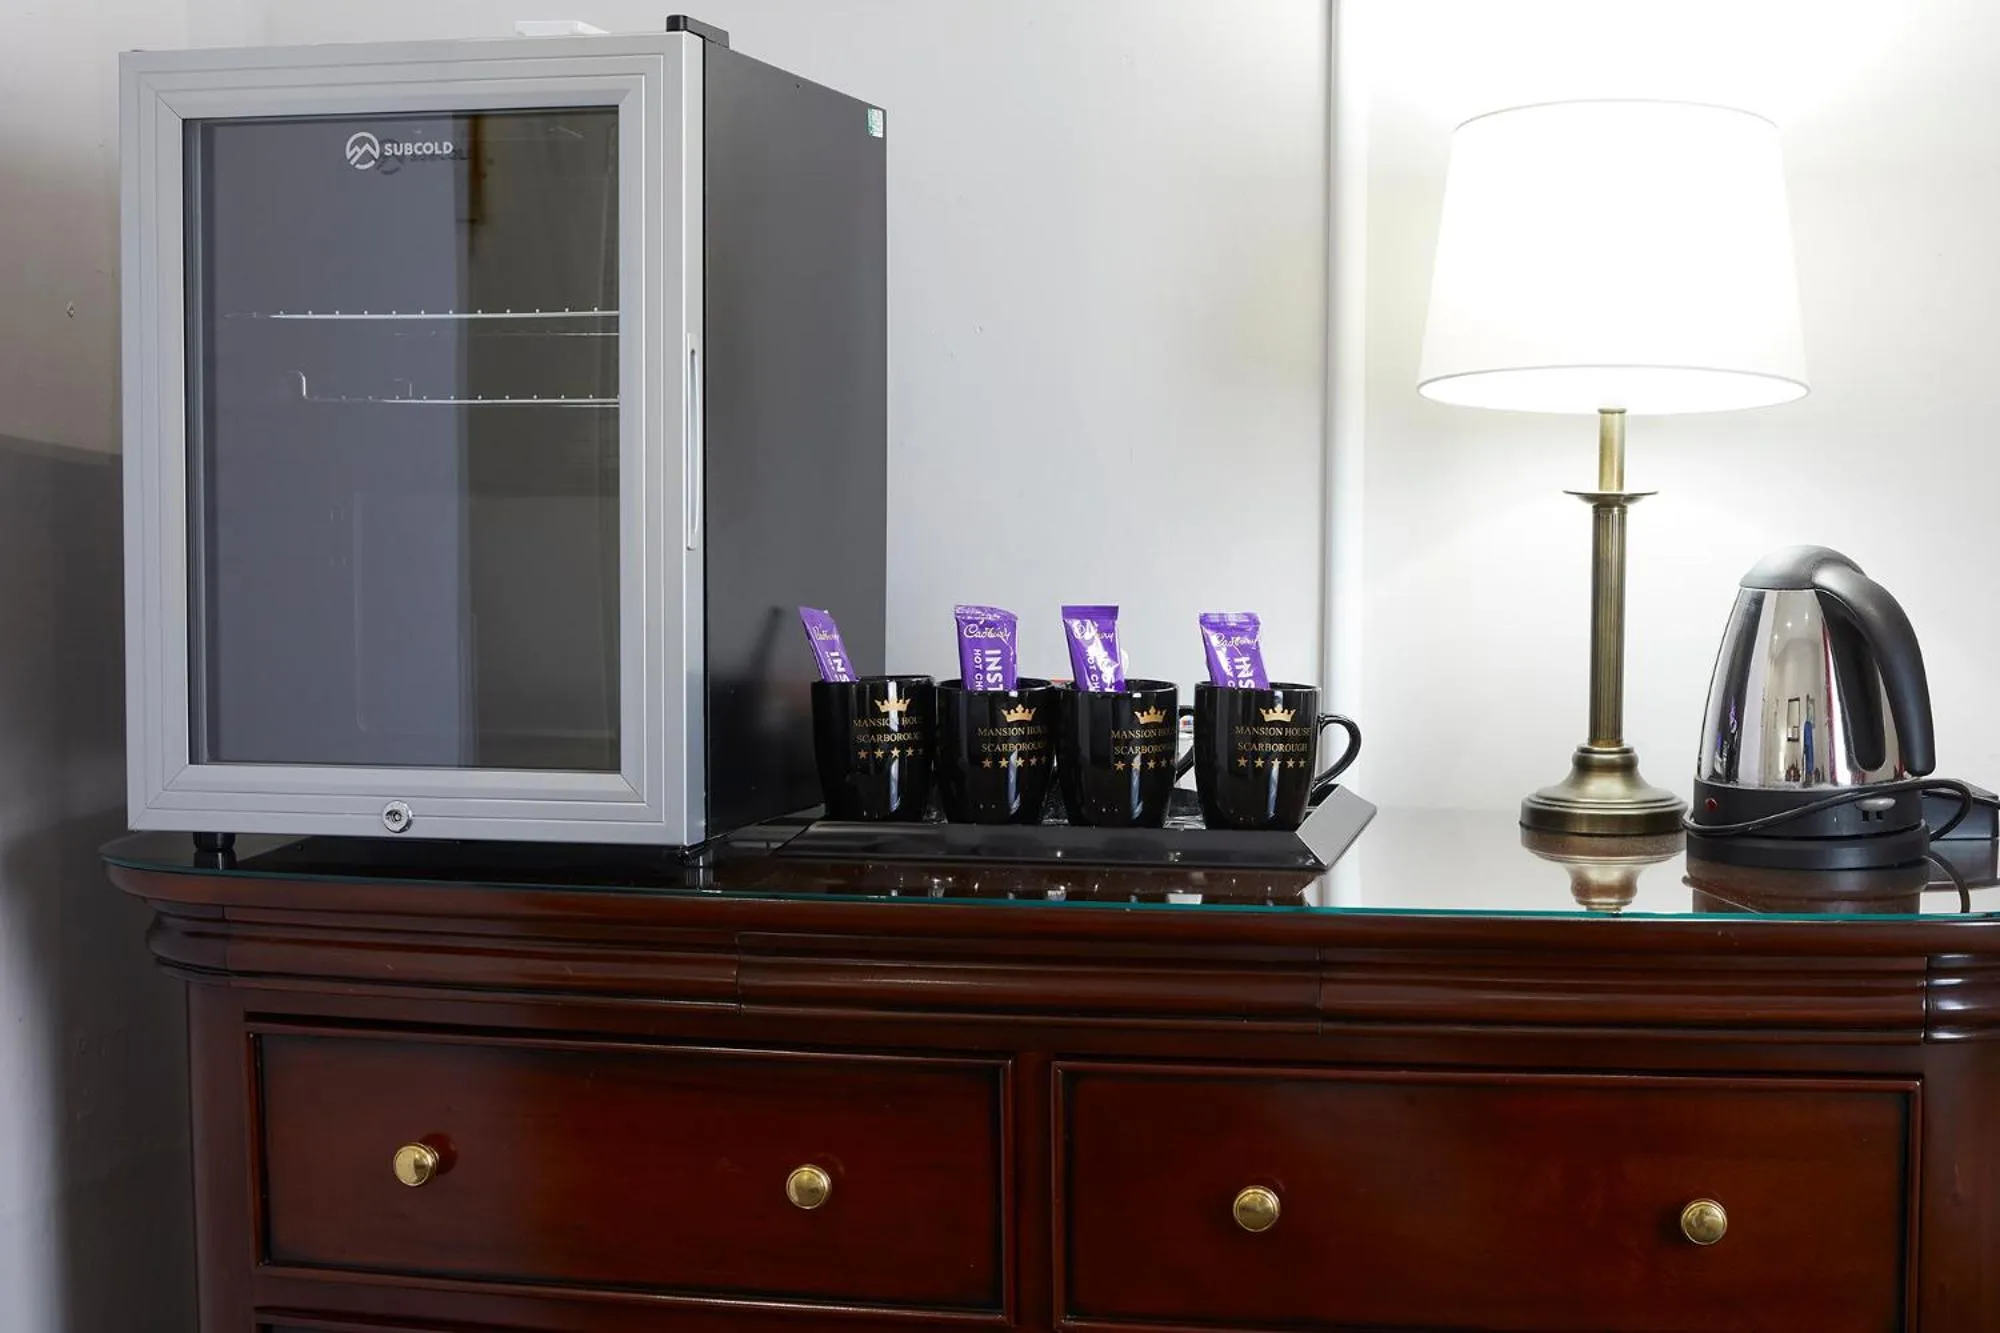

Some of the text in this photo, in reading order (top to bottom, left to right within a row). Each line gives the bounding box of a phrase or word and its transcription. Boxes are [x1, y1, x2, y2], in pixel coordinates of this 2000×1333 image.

[384, 141, 454, 156] SUBCOLD
[973, 648, 983, 670] HOT
[853, 718, 899, 727] MANSIO
[978, 727, 1025, 737] MANSION
[1110, 728, 1157, 739] MANSION
[1234, 726, 1312, 737] MANSION HOUSE
[1237, 742, 1308, 753] SCARBOROUGH
